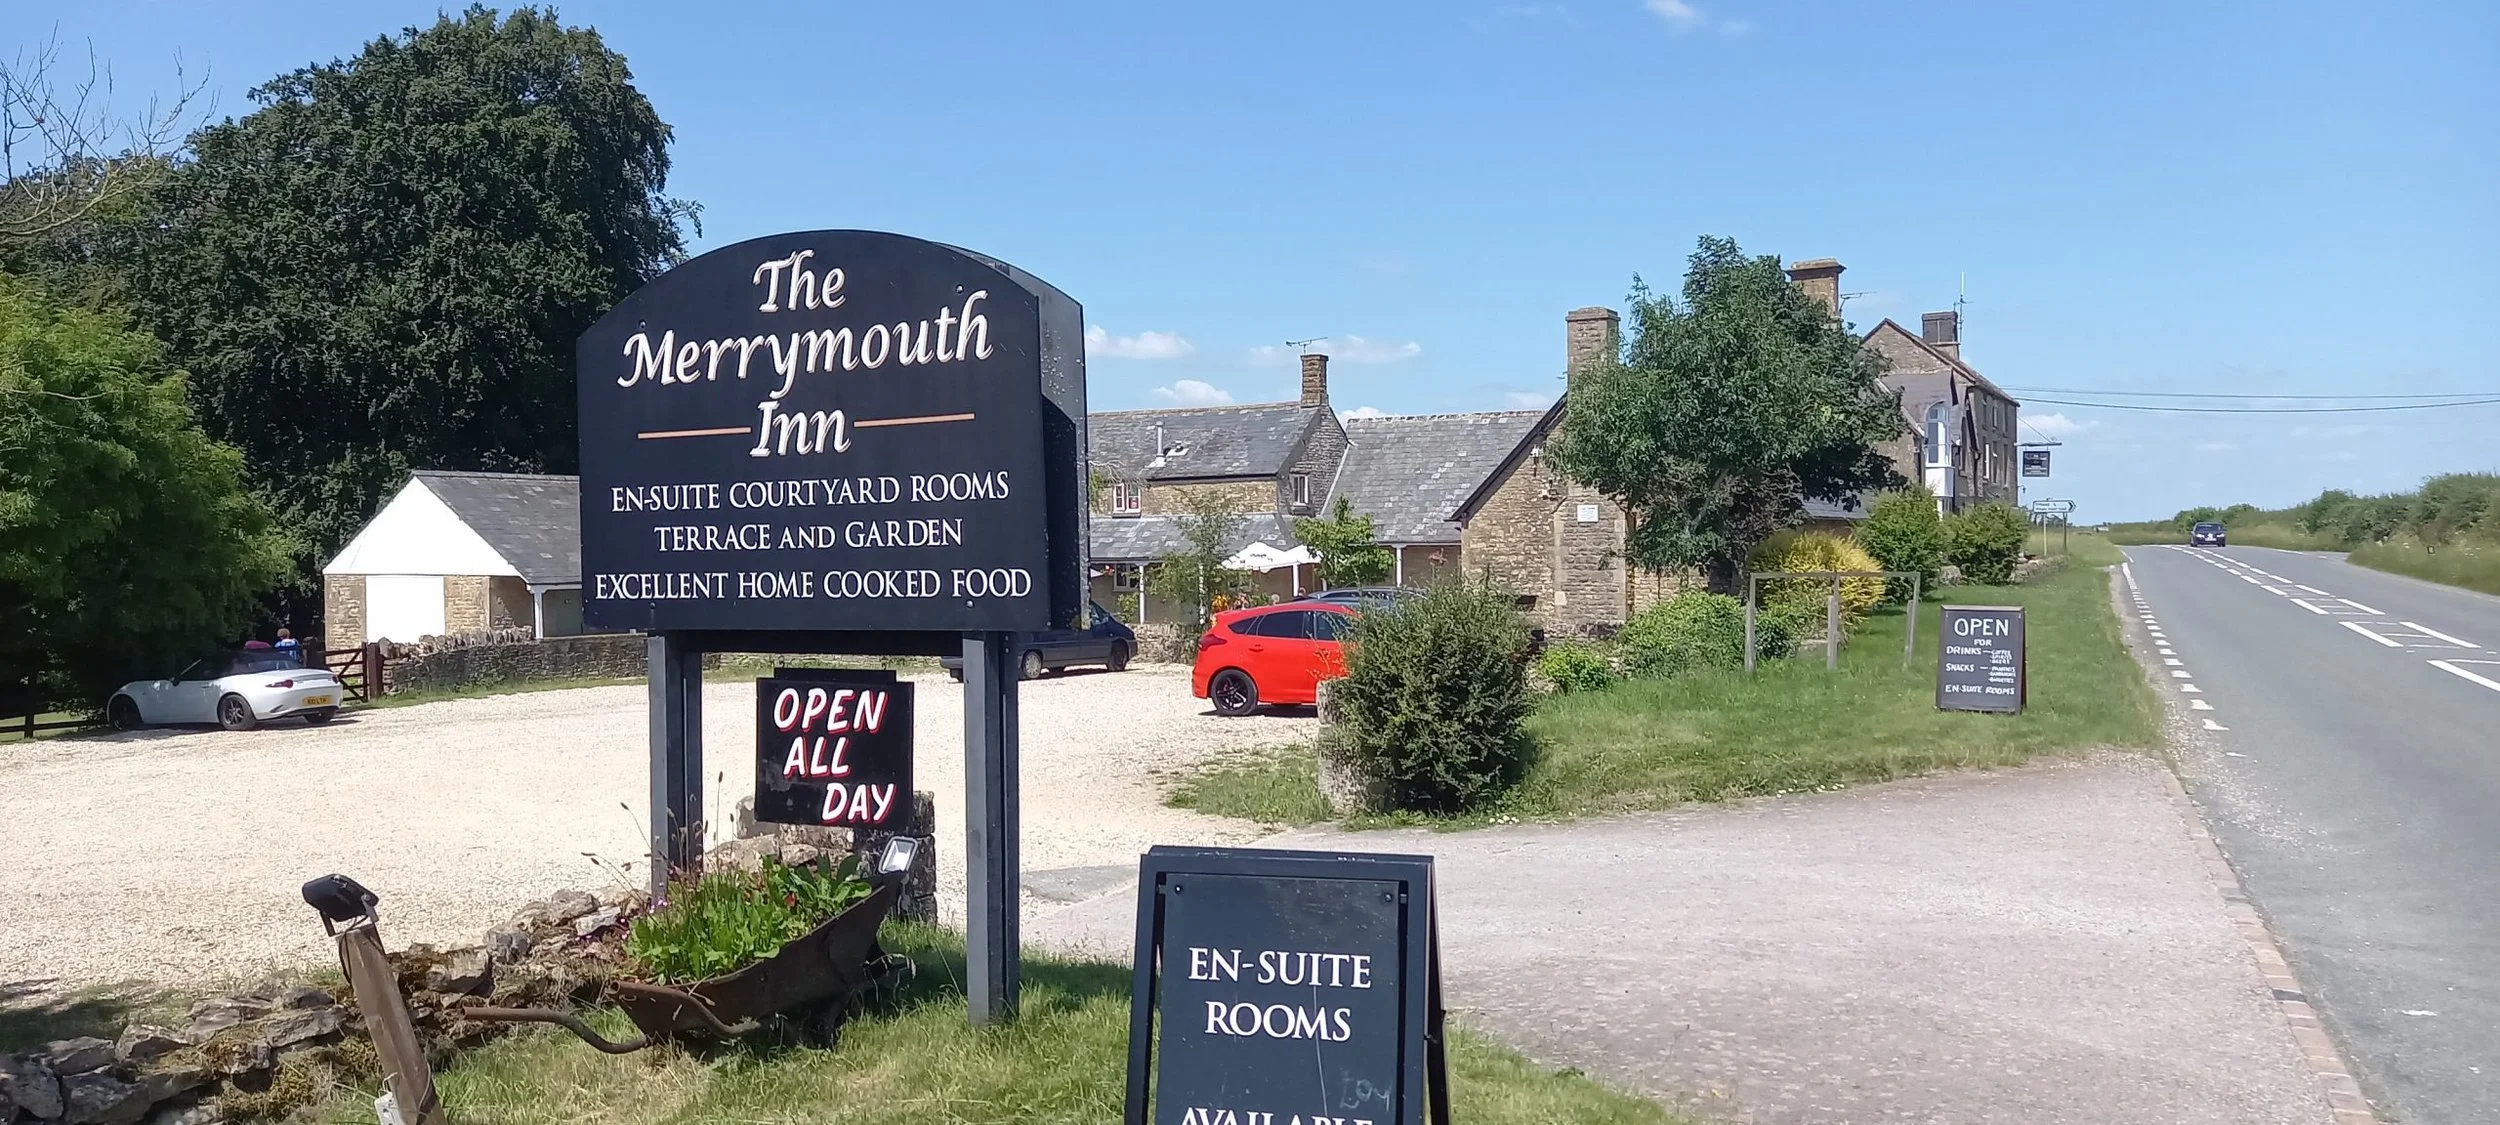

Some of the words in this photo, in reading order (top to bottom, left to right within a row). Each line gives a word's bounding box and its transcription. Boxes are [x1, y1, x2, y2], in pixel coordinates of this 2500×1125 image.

[752, 249, 846, 313] The
[616, 289, 994, 399] Merrymouth
[750, 400, 851, 458] Inn
[610, 483, 721, 512] EN-SUITE
[729, 476, 900, 509] COURTYARD
[909, 470, 1009, 502] ROOMS
[653, 523, 772, 552] TERRACE
[777, 525, 836, 549] AND
[844, 518, 963, 548] GARDEN
[594, 572, 729, 600] EXCELLENT
[737, 571, 814, 599] HOME
[823, 569, 941, 599] COOKED
[950, 568, 1032, 598] FOOD
[1954, 617, 2009, 636] OPEN
[1973, 638, 1993, 647] FOR
[1945, 663, 1975, 672] SNACKS
[1946, 645, 1982, 655] DRINKS
[773, 687, 888, 734] OPEN
[1985, 686, 2015, 695] ROOMS
[783, 736, 852, 779] ALL
[822, 782, 897, 825] DAY
[1188, 947, 1372, 989] EN-SUITE
[1204, 1000, 1351, 1042] ROOMS
